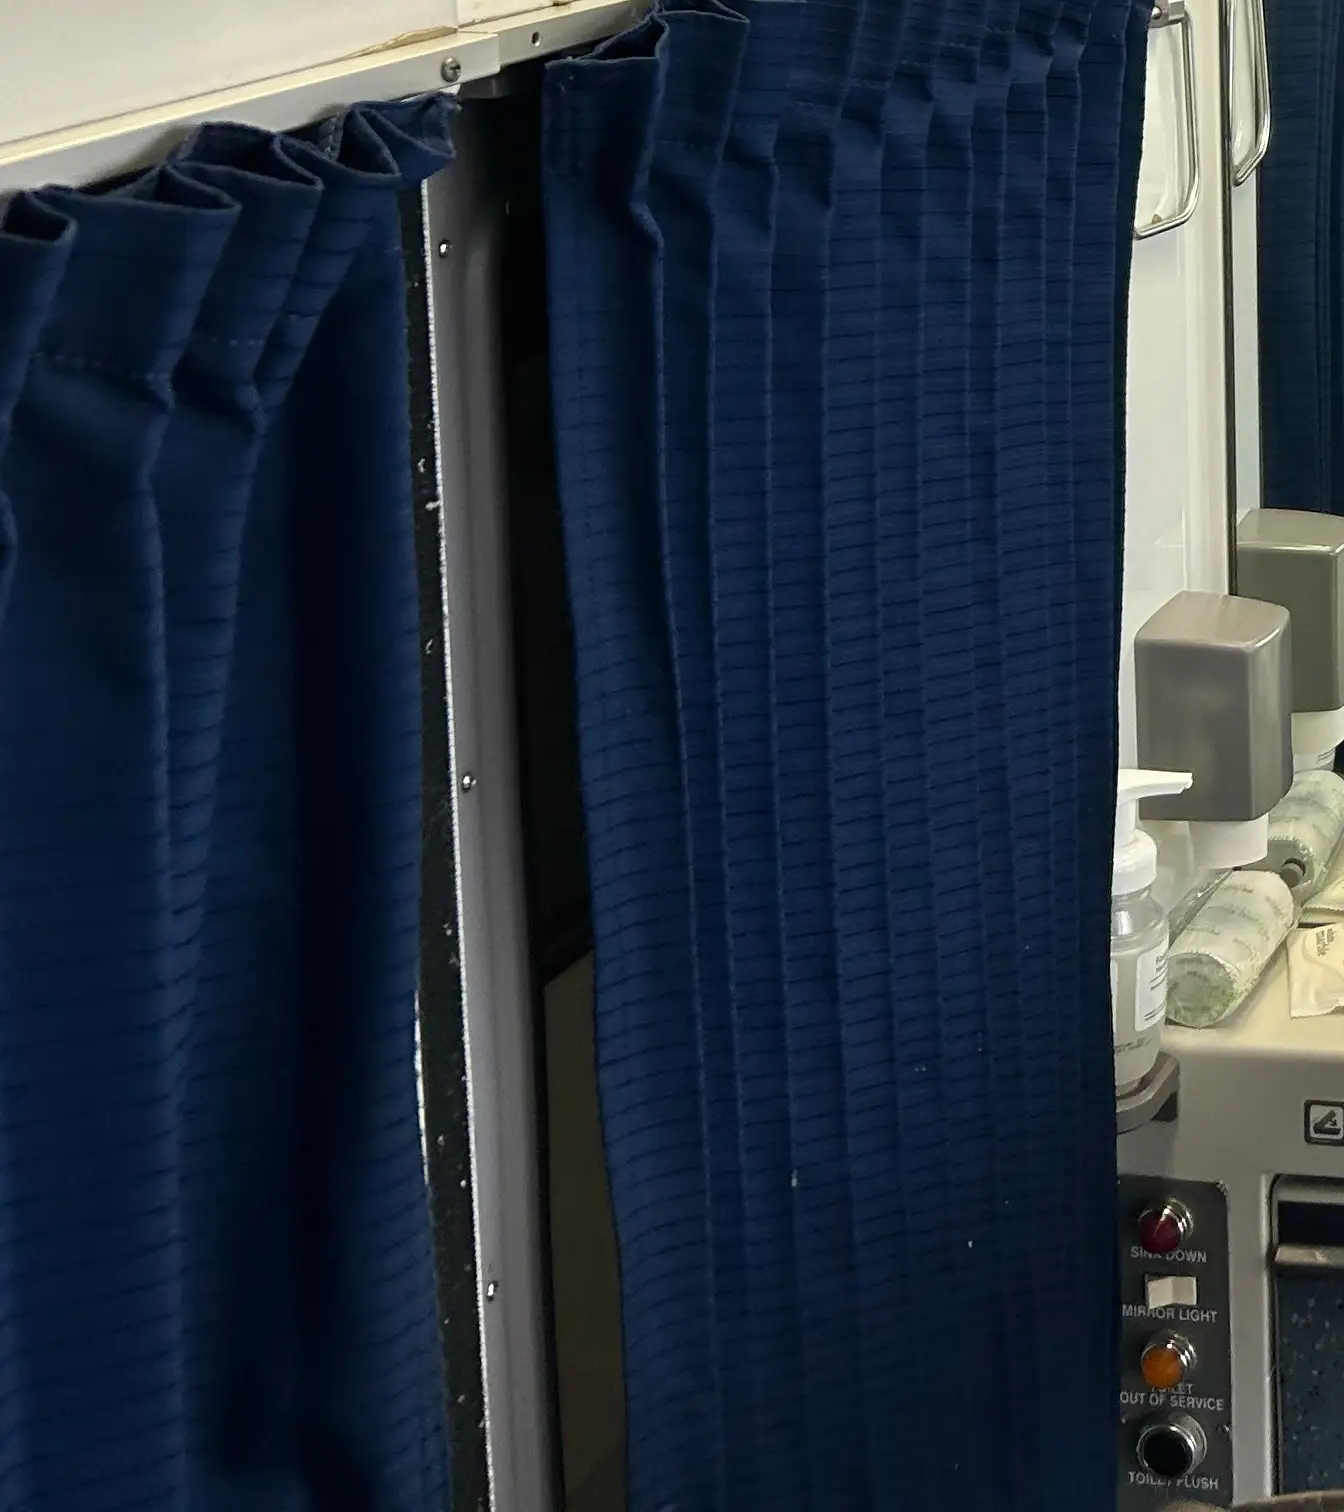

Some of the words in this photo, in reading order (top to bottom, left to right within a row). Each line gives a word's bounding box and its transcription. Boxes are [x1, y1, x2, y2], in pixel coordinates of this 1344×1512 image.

[1165, 1248, 1207, 1263] DOWN
[1122, 1303, 1175, 1319] MIRROR
[1179, 1308, 1218, 1323] LIGHT
[1120, 1391, 1146, 1404] OUT
[1149, 1392, 1167, 1406] OF
[1170, 1395, 1225, 1410] SERVICE
